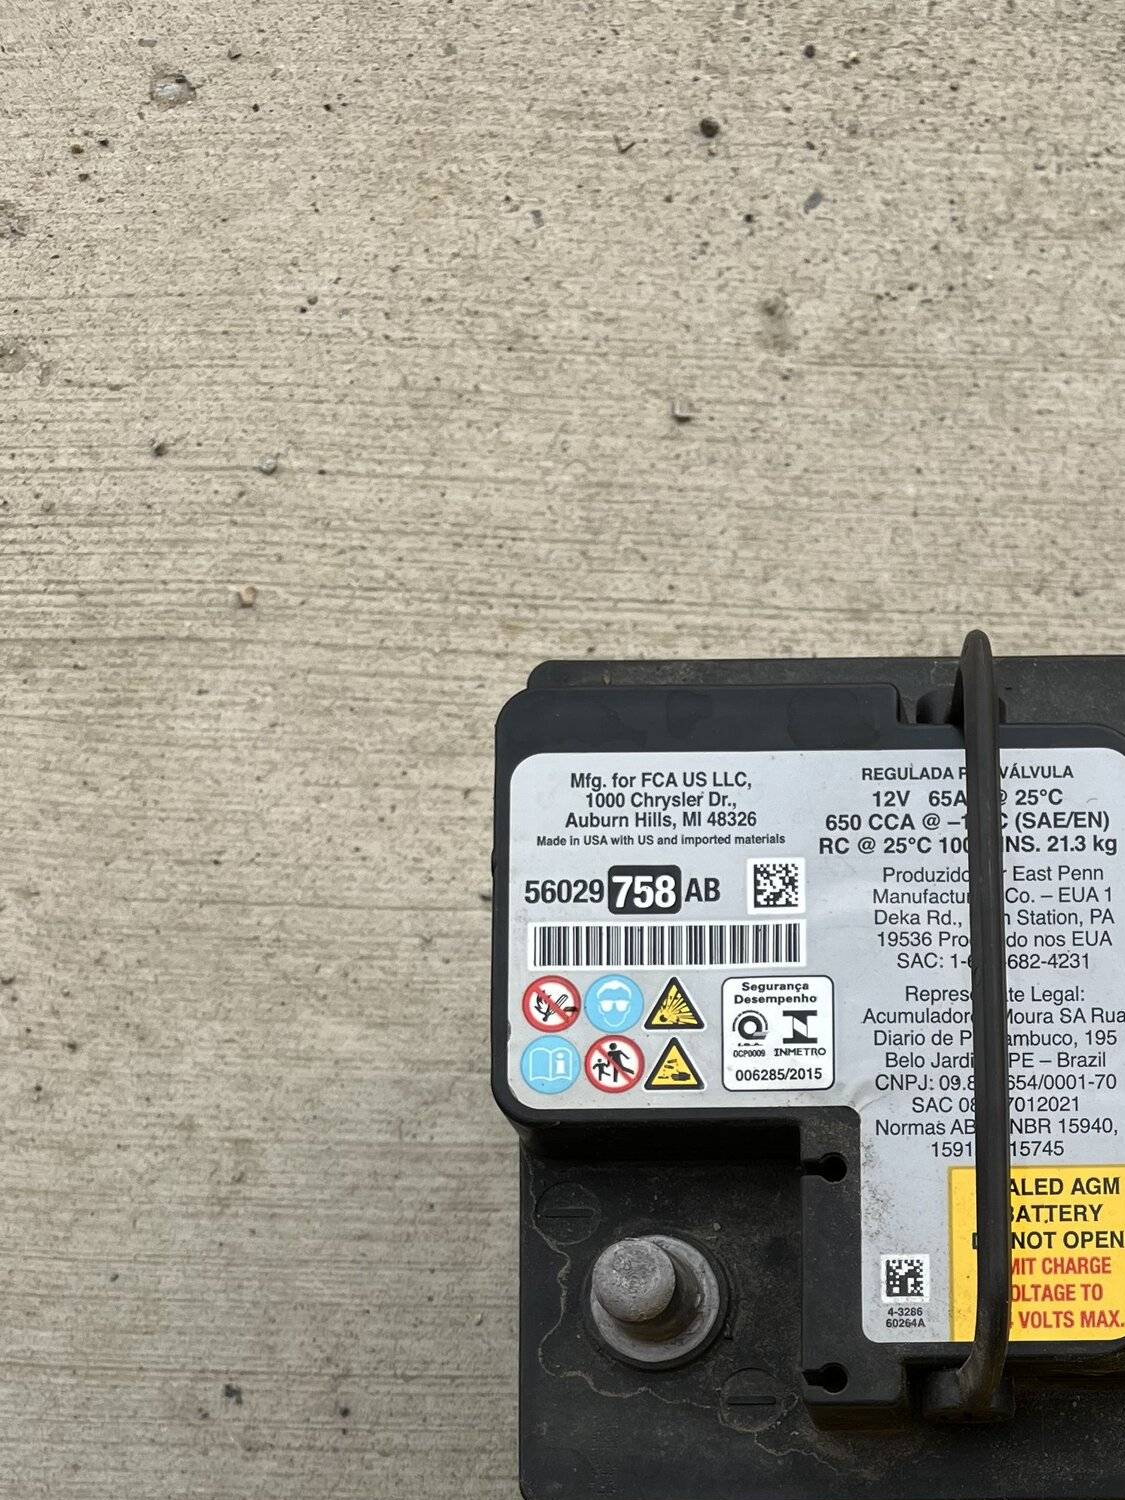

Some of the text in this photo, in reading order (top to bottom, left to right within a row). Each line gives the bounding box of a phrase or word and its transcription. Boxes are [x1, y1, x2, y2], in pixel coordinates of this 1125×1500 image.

[571, 771, 751, 792] Mfg. for FCA US LLC,
[862, 767, 950, 781] REGULADA
[586, 791, 736, 811] 1000 Chrysler Dr.,
[872, 788, 1063, 807] 12V 25°C
[565, 811, 757, 830] Auburn Hills, MI 48326
[826, 811, 1109, 833] 650 CCA (SAE/EN)
[537, 833, 786, 847] Made in USA with US and imported materials
[819, 834, 1117, 856] RC 25°C 21.3 kg
[1013, 865, 1104, 881] East Penn
[612, 875, 676, 908] 758
[684, 877, 720, 902] AB
[874, 908, 1115, 928] Deka Rd., Station, PA
[742, 982, 809, 993] Segurança
[734, 993, 817, 1005] Desempenho
[774, 1047, 826, 1057] INMETRO
[885, 1051, 1106, 1068] Belo Brazil
[735, 1068, 822, 1081] 006285/2015
[875, 1074, 934, 1091] CNPJ:
[876, 1118, 1118, 1136] Normas 15940,
[1011, 1140, 1064, 1156] 15745
[1042, 1256, 1111, 1275] CHARGE
[1018, 1310, 1125, 1329] VOLTS MAX.
